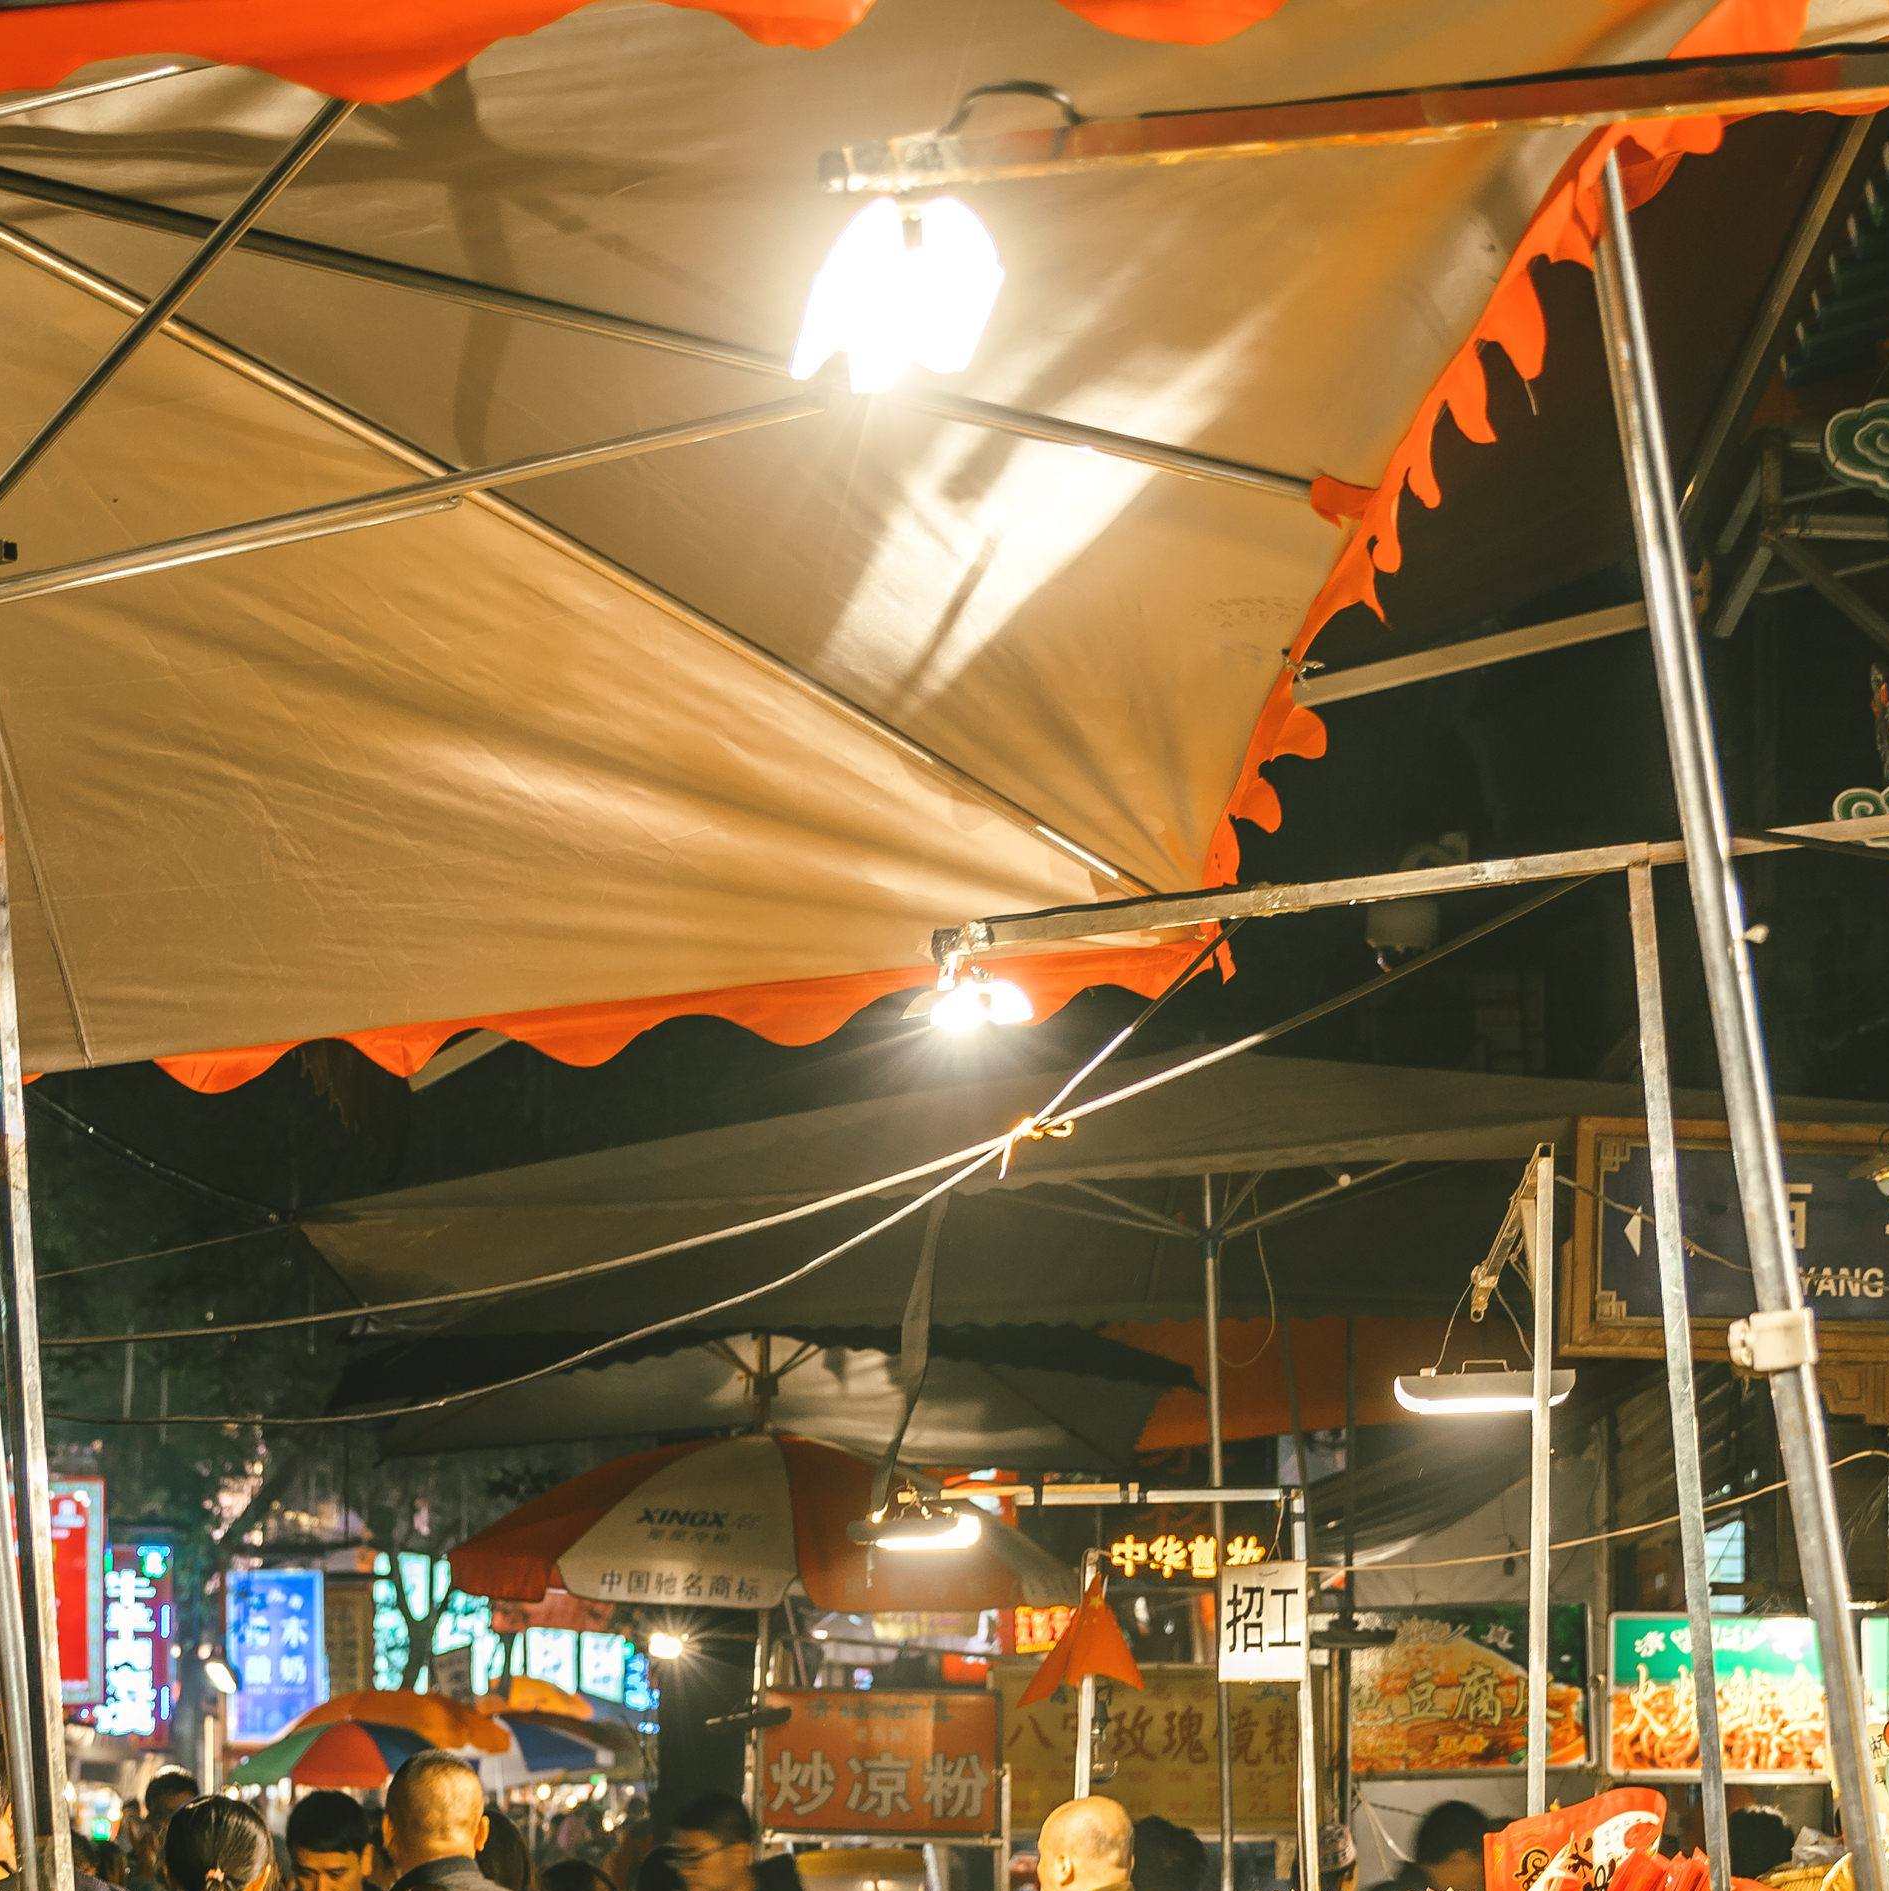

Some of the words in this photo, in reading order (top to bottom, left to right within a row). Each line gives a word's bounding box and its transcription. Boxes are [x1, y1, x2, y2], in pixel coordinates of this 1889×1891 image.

[601, 1569, 760, 1601] 中国驰名商标
[1226, 1583, 1302, 1653] 招工
[768, 1750, 990, 1819] 炒凉粉
